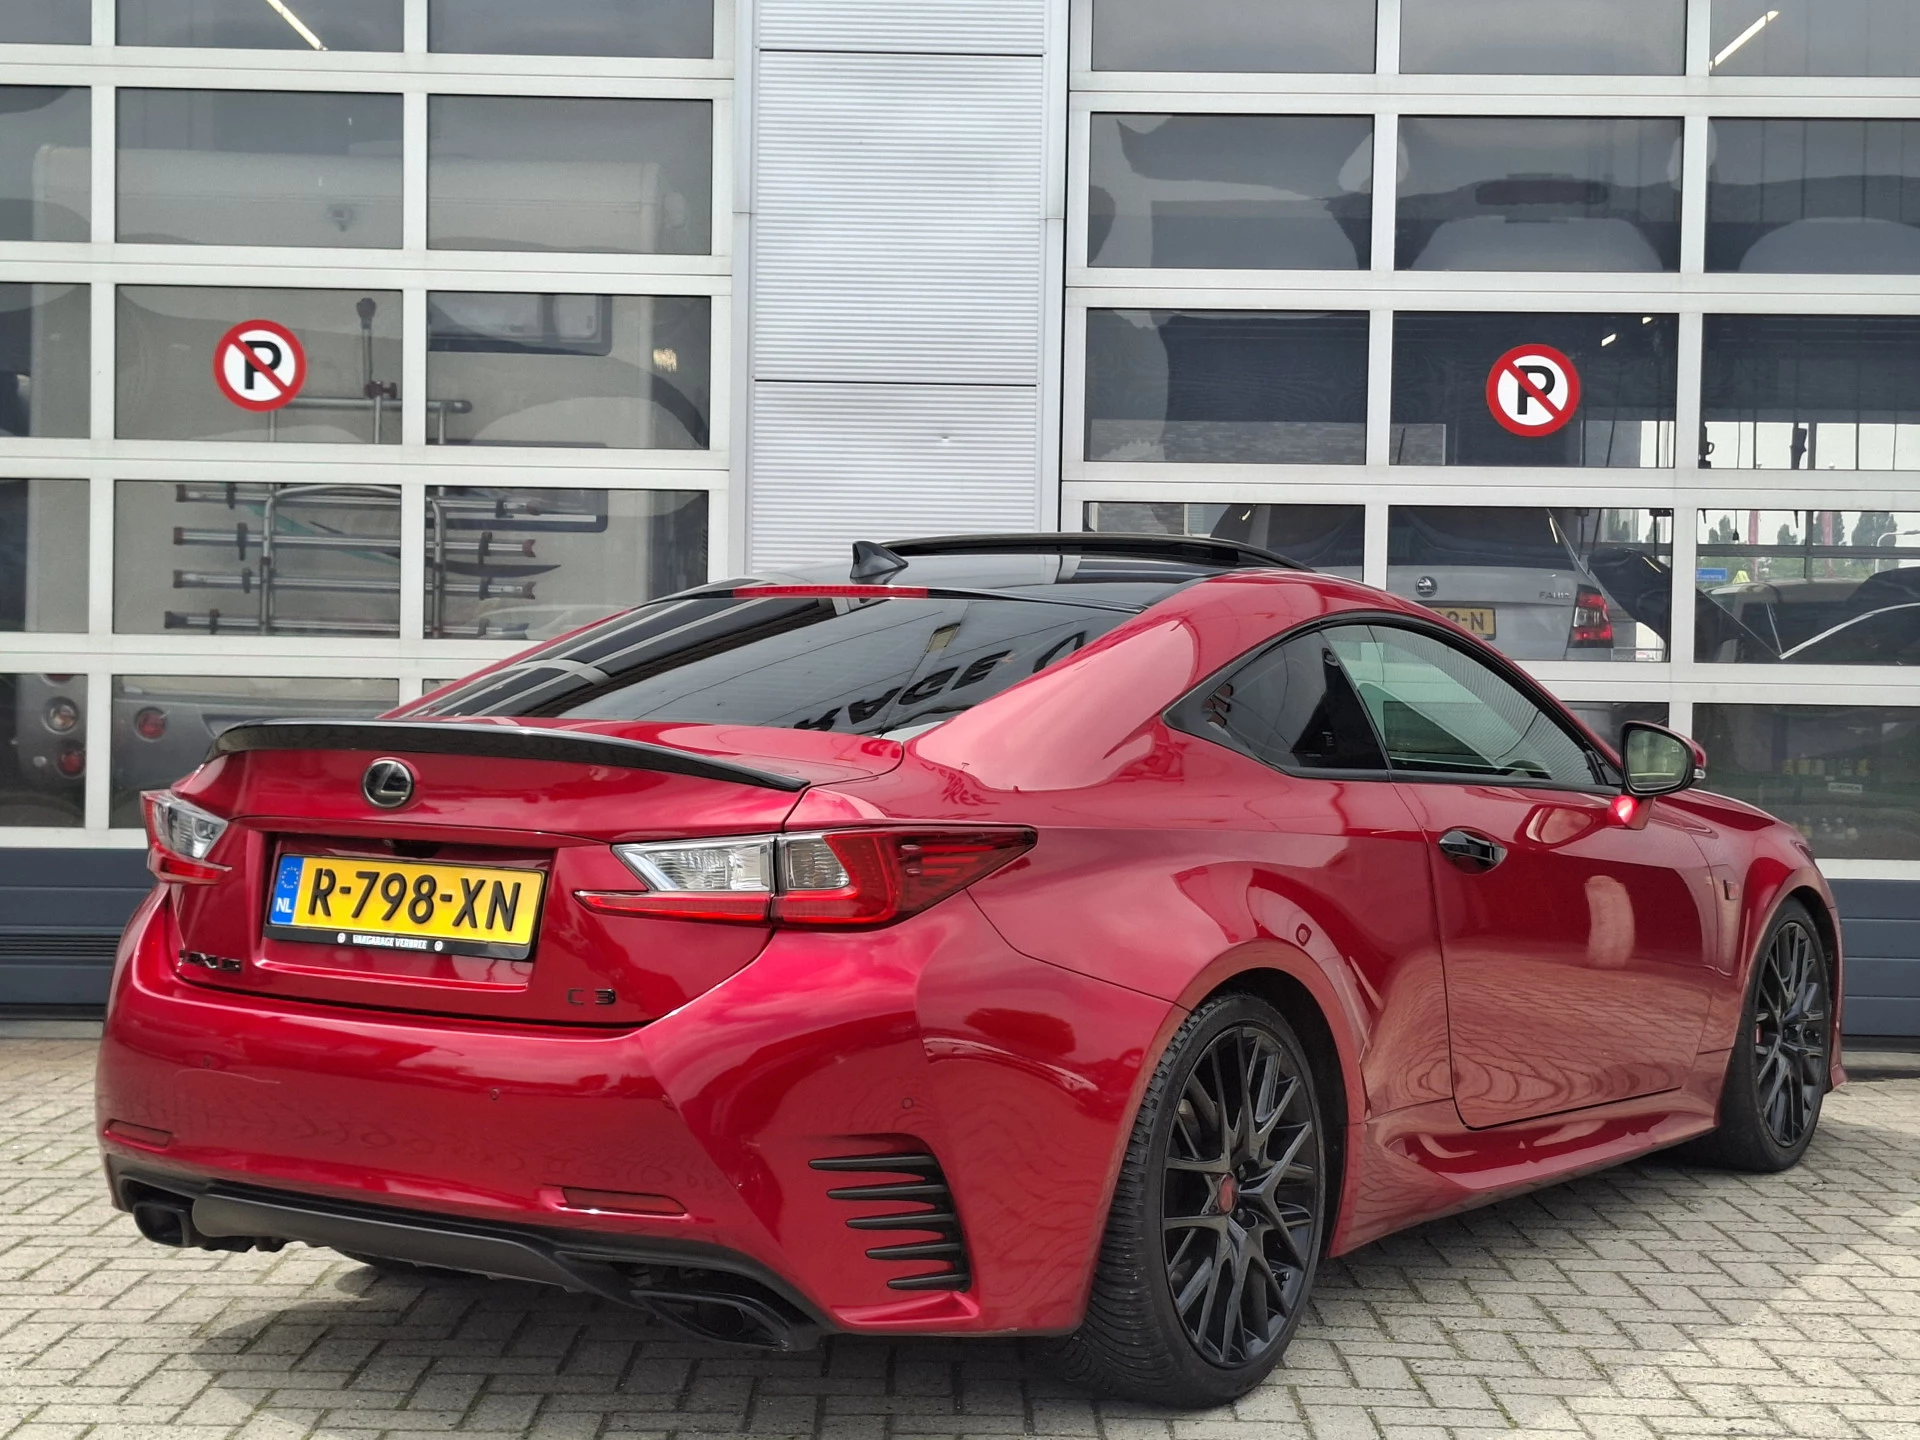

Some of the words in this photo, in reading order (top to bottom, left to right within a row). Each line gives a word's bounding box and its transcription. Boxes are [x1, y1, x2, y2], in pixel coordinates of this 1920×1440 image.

[244, 340, 282, 390] P
[1517, 365, 1555, 415] P
[276, 898, 292, 913] NL
[308, 867, 521, 932] R-798-XN
